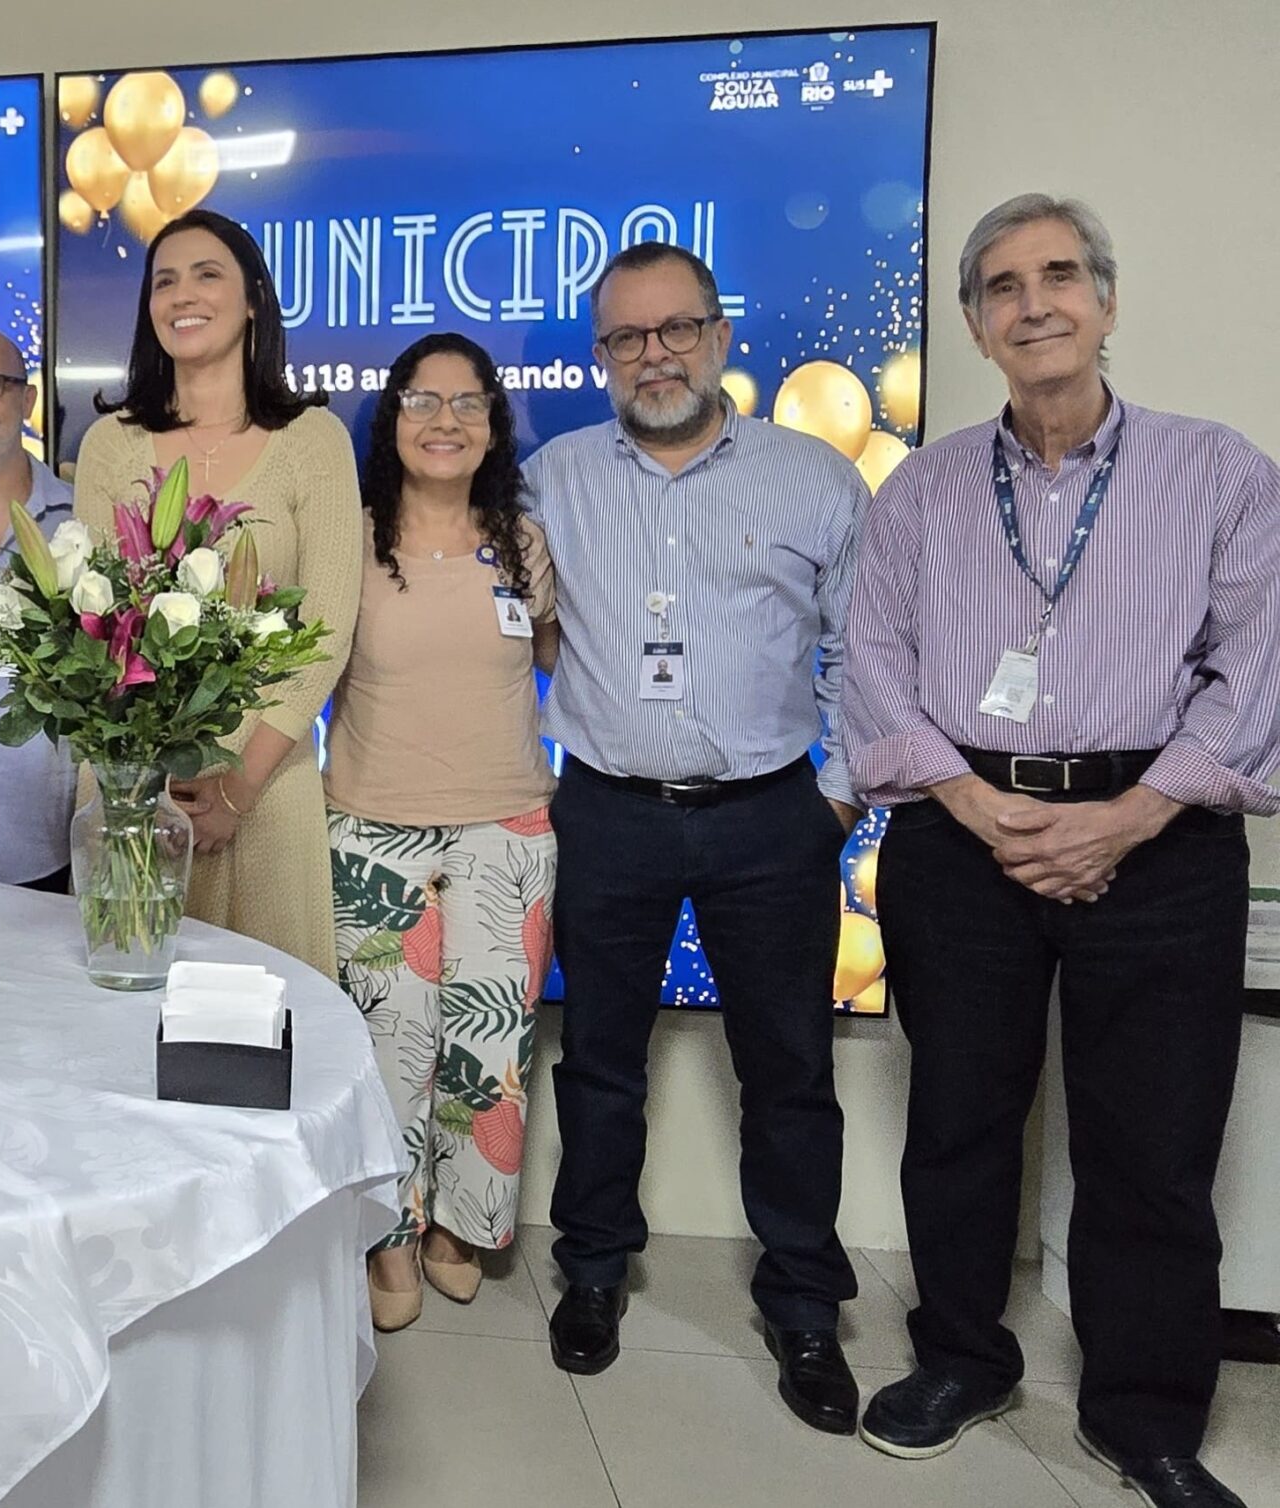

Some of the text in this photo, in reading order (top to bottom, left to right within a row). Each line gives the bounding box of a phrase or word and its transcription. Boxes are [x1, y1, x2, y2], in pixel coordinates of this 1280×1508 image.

[714, 79, 776, 96] SOUZA
[801, 85, 836, 102] RIO
[843, 79, 865, 92] SUS
[709, 93, 780, 111] AGUIAR
[302, 363, 354, 392] 118
